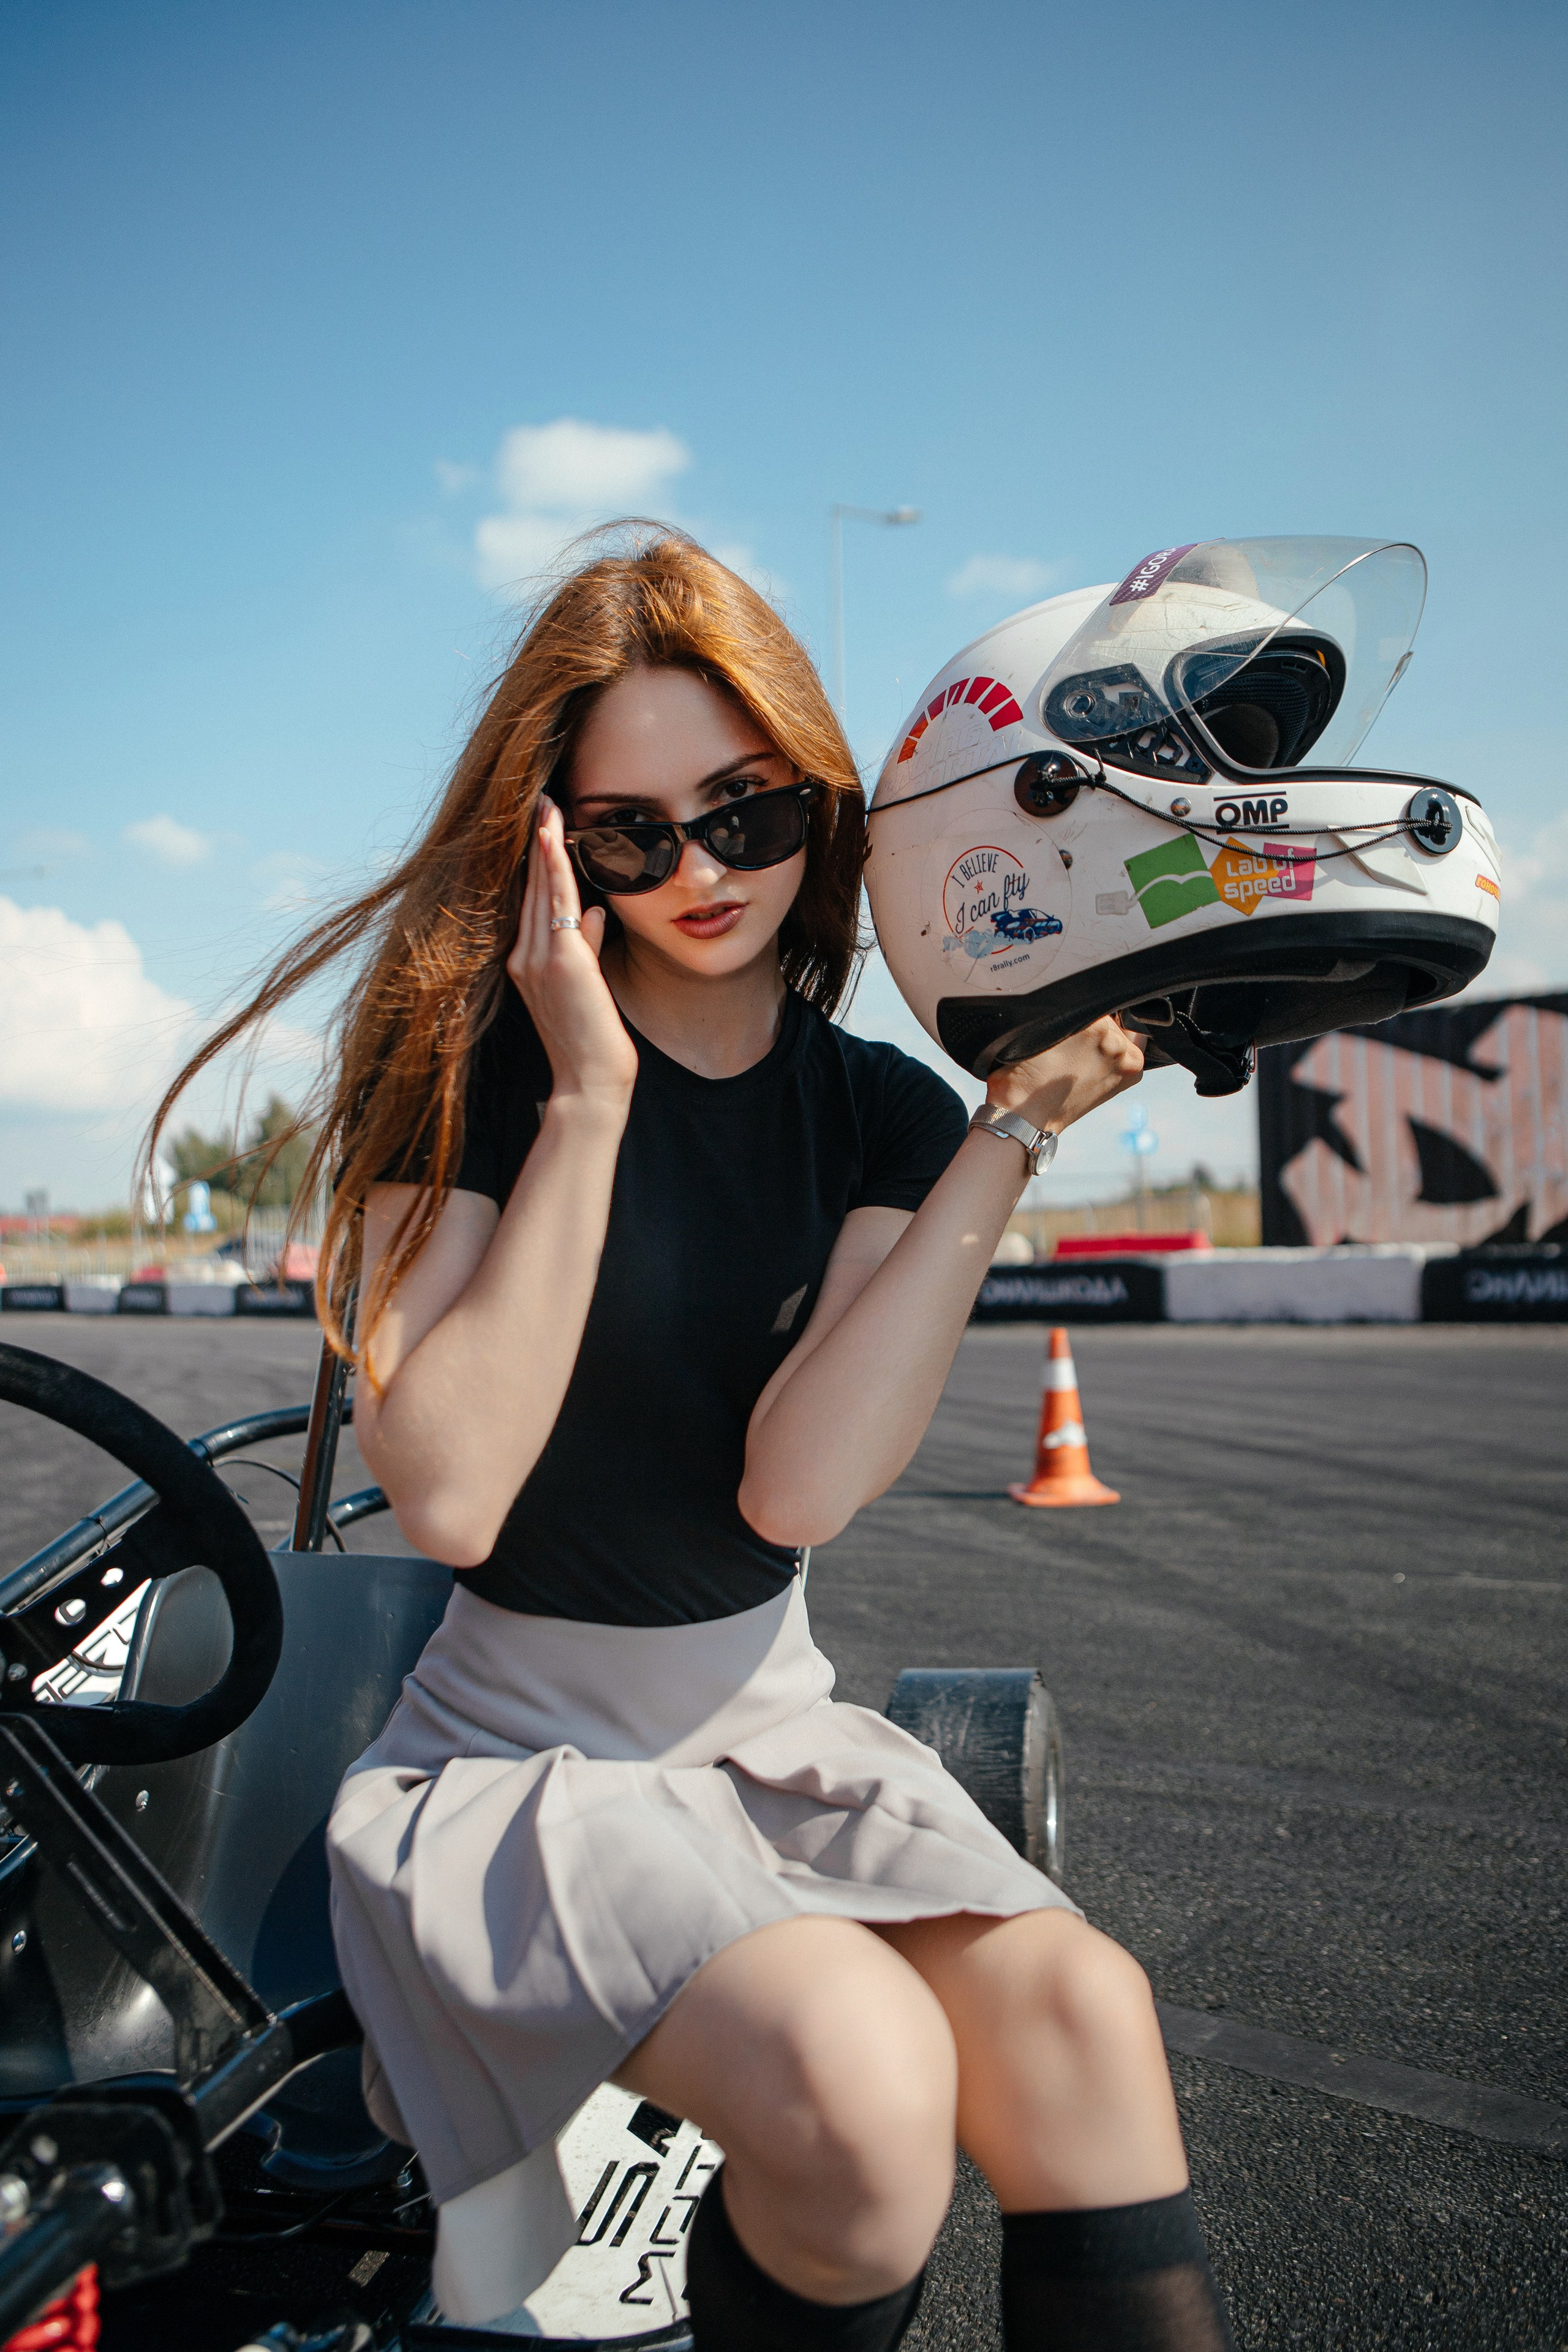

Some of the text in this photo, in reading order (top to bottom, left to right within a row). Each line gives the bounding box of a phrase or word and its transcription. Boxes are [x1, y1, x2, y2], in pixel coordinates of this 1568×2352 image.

[1215, 797, 1288, 826] OMP
[951, 853, 1000, 889] I BELIEVE
[1224, 869, 1296, 904] speed
[955, 902, 965, 935] I
[970, 892, 1000, 922] can
[990, 953, 1031, 973] r8rally.com
